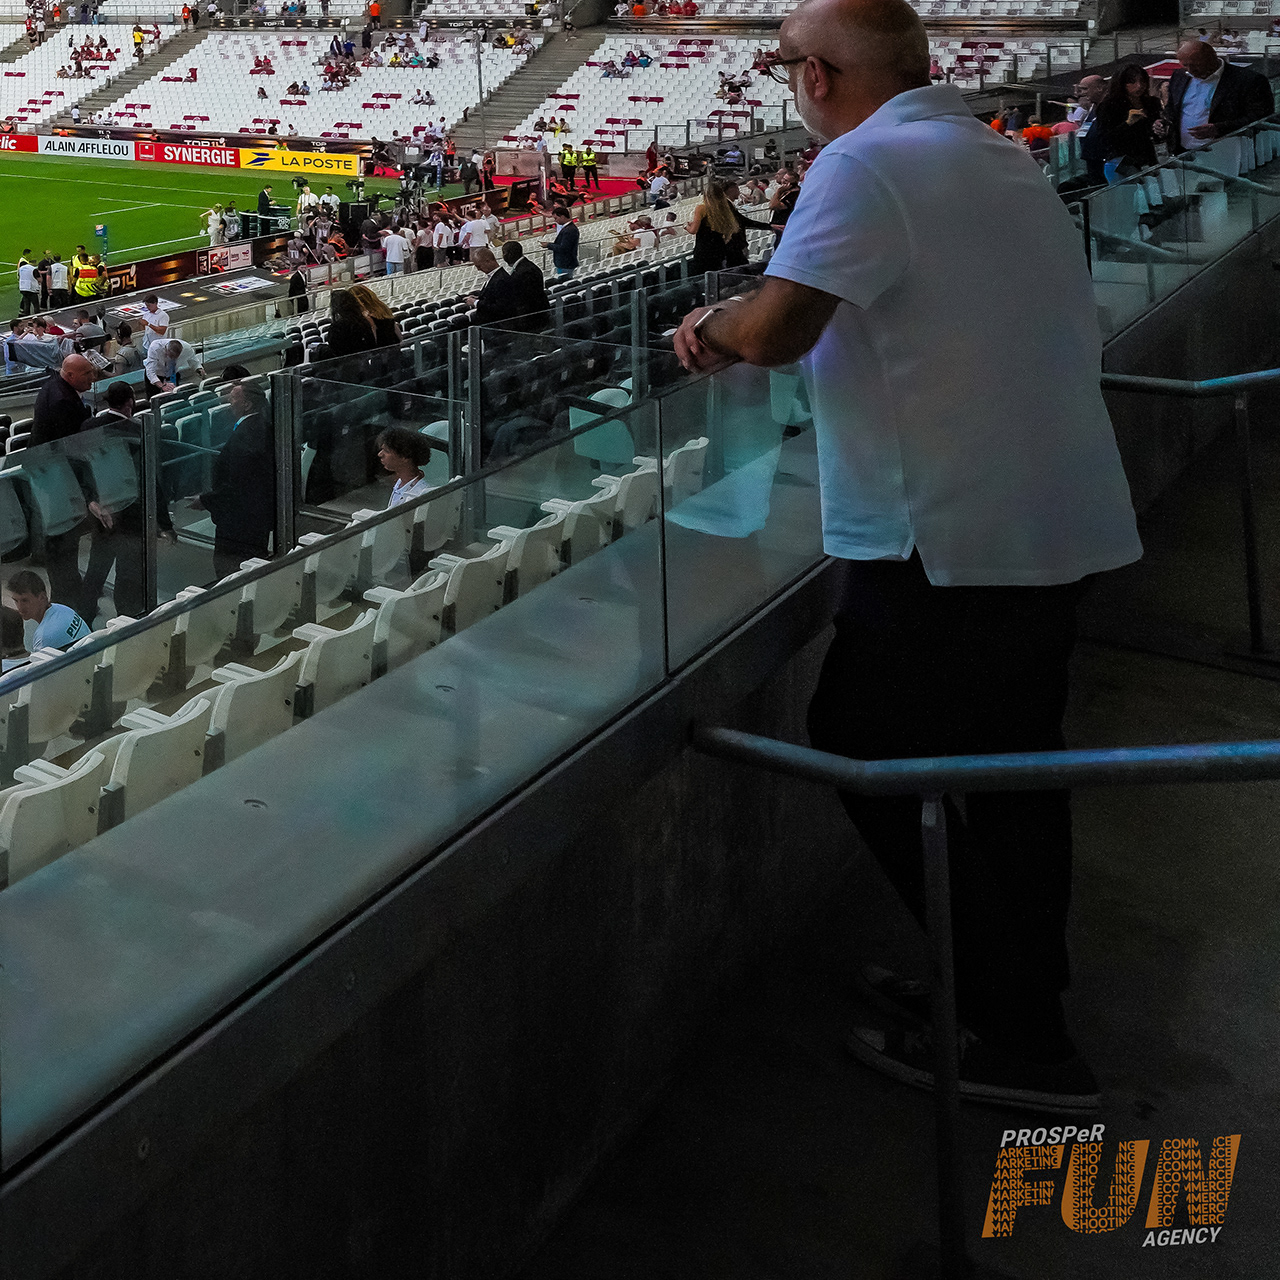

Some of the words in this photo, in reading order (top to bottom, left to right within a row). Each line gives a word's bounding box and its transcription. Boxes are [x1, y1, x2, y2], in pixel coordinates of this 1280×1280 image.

[44, 140, 76, 152] ALAIN
[77, 142, 129, 156] AFFLELOU
[163, 146, 236, 166] SYNERGIE
[281, 156, 302, 167] LA
[303, 157, 353, 170] POSTE
